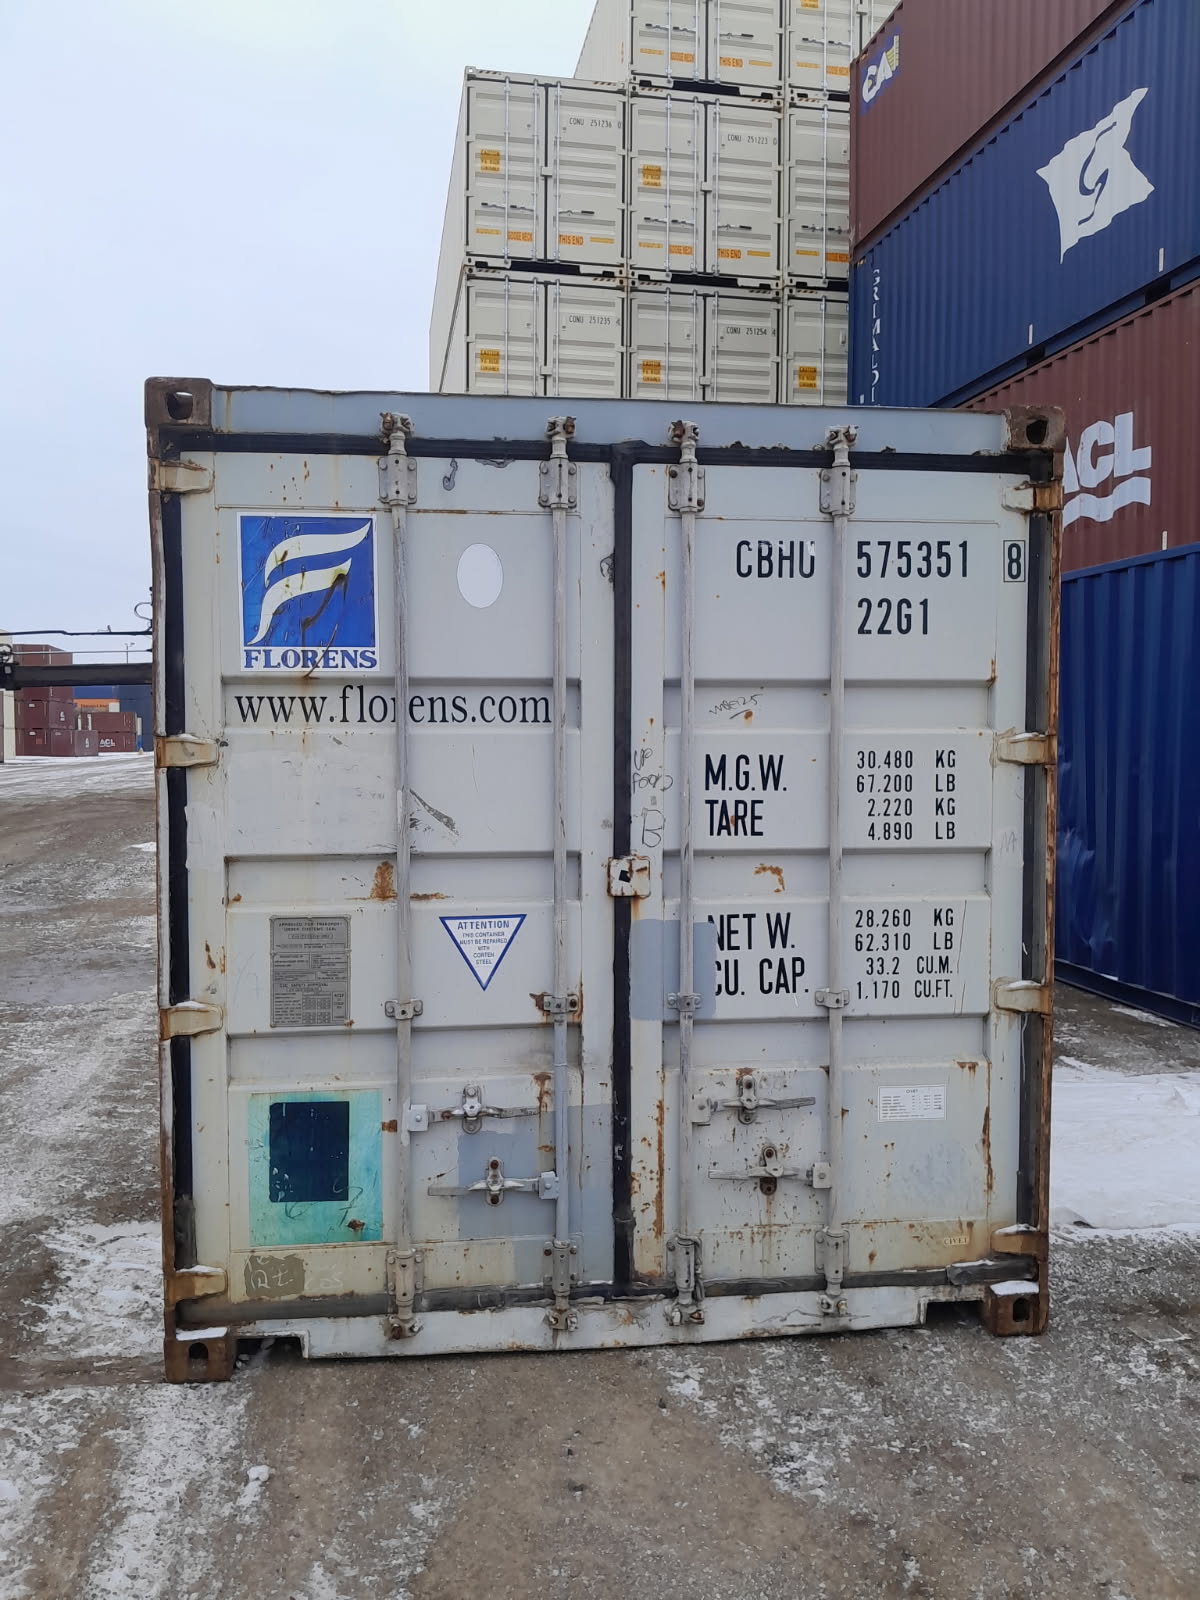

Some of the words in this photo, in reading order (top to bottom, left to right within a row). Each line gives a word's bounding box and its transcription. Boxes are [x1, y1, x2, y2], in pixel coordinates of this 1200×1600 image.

[572, 235, 584, 246] END
[737, 540, 815, 579] CBHU
[858, 540, 968, 579] 575351
[1008, 543, 1022, 580] 8
[858, 598, 929, 635] 22G1
[244, 649, 377, 669] FLORENS
[705, 754, 787, 792] M.G.W.
[935, 749, 956, 769] KG
[935, 773, 956, 793] LB
[705, 799, 764, 837] TARE
[935, 797, 956, 816] KG
[935, 821, 956, 840] LB
[457, 920, 510, 930] ATTENTION
[766, 911, 795, 949] W.
[933, 907, 954, 927] KG
[933, 931, 953, 950] LB
[759, 956, 809, 995] CAP.
[866, 956, 900, 976] 33.2
[917, 955, 953, 975] CU.M.
[914, 979, 953, 998] CU.FT.
